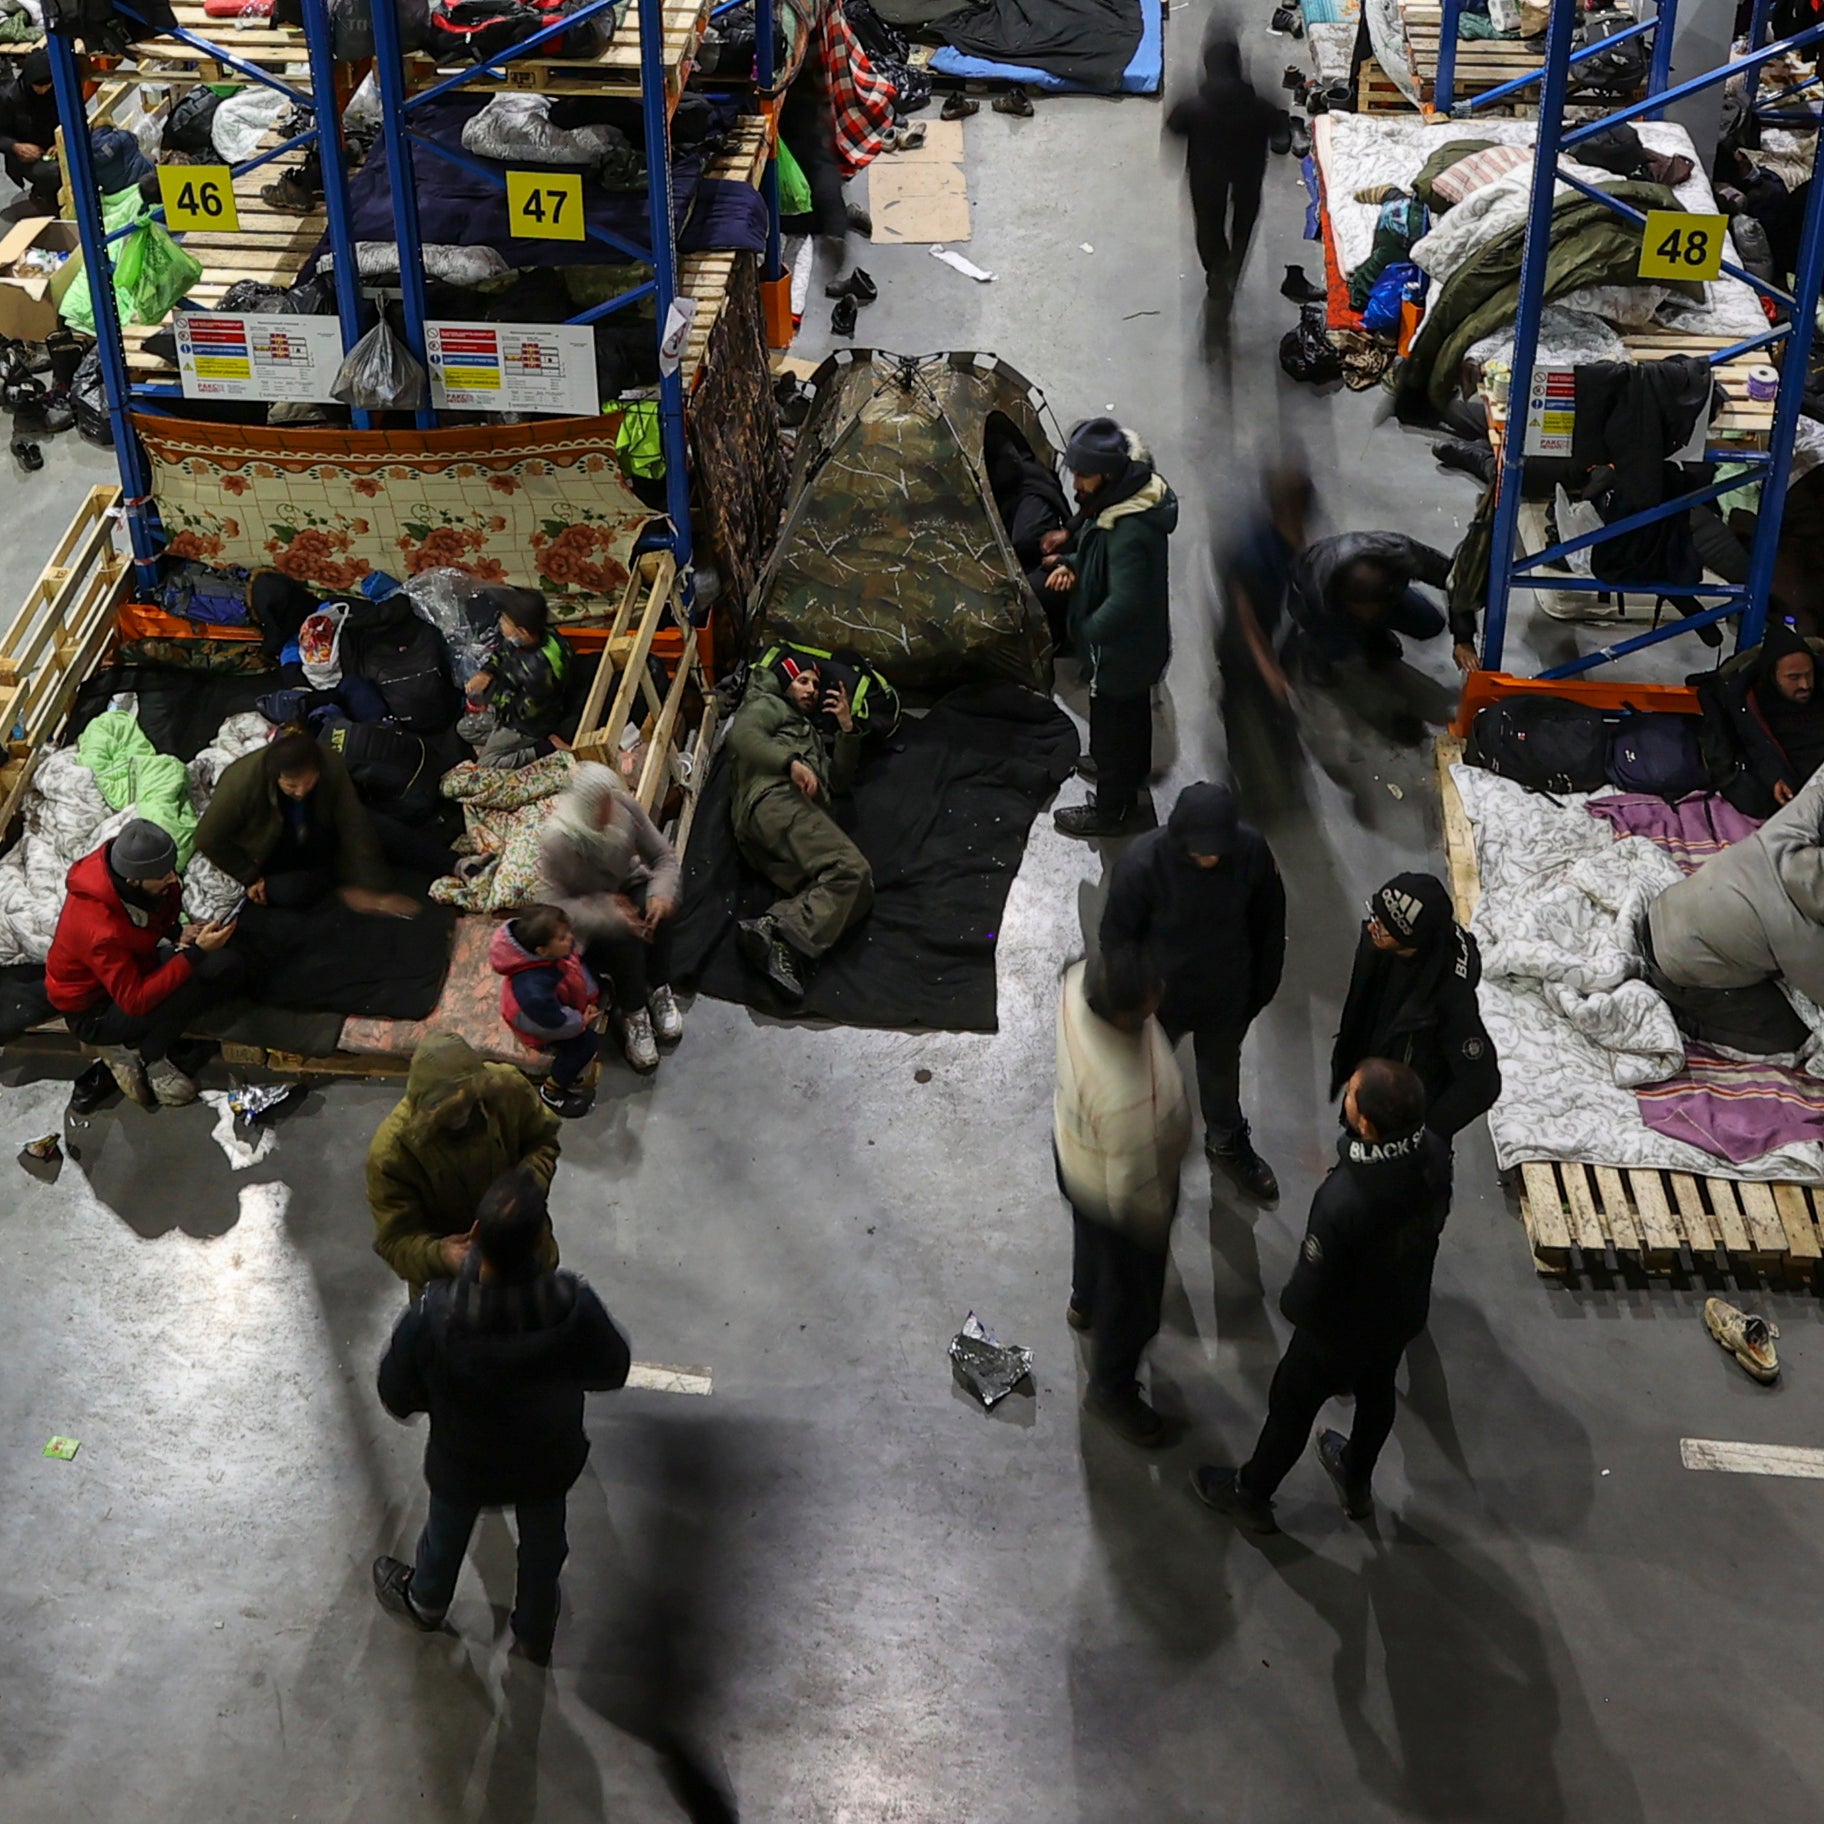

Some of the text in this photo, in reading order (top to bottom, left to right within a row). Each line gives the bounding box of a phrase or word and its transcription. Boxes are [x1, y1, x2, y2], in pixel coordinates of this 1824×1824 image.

[176, 181, 223, 217] 46
[522, 188, 568, 224] 47
[1655, 228, 1709, 266] 48
[1382, 888, 1414, 937] adidas
[1349, 1137, 1411, 1164] BLACK
